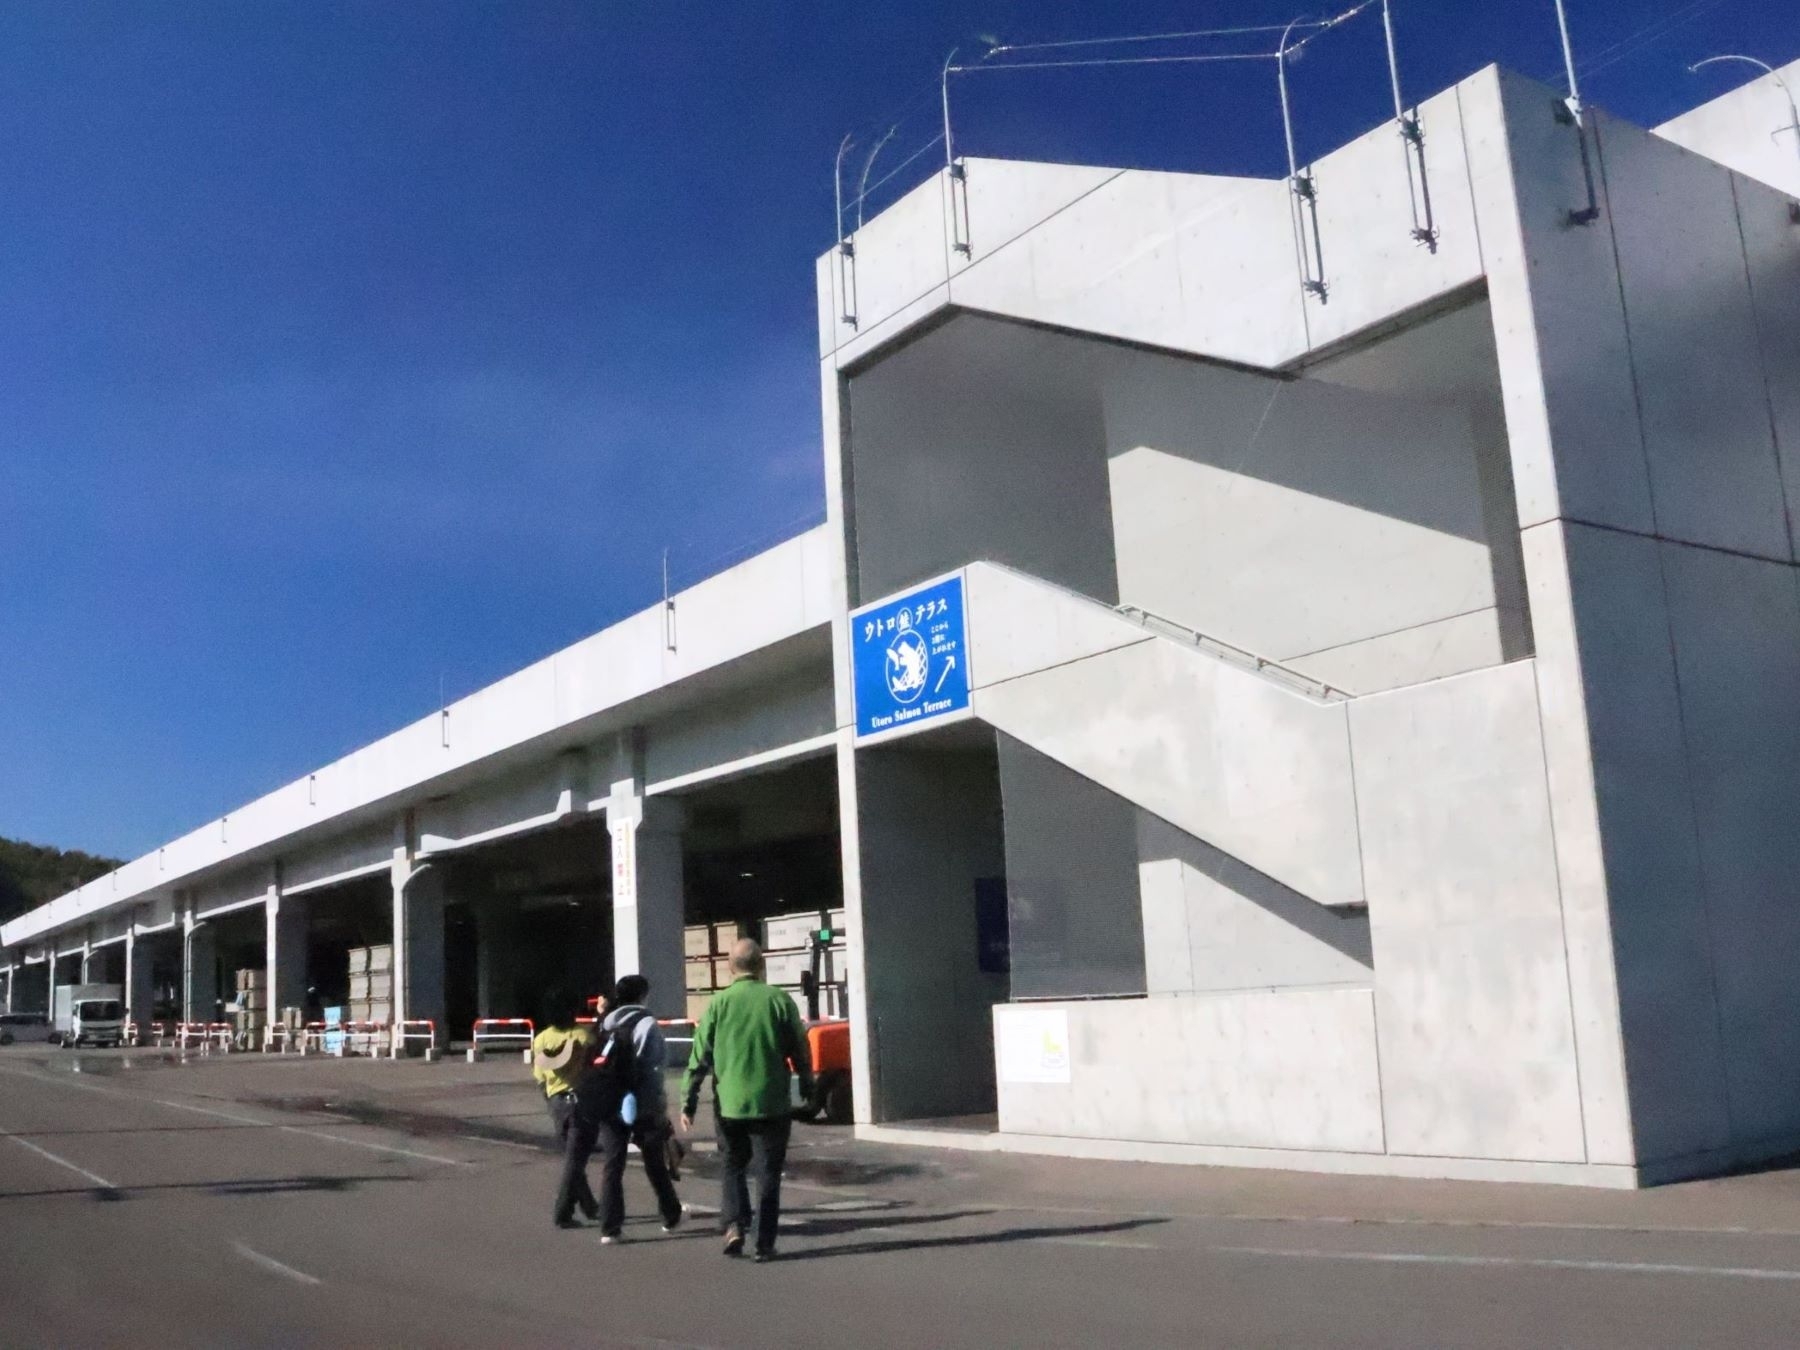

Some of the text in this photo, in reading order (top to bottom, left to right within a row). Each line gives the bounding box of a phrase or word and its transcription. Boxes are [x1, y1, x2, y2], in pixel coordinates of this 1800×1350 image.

[872, 699, 952, 728] Utoro Salmon Terrace
